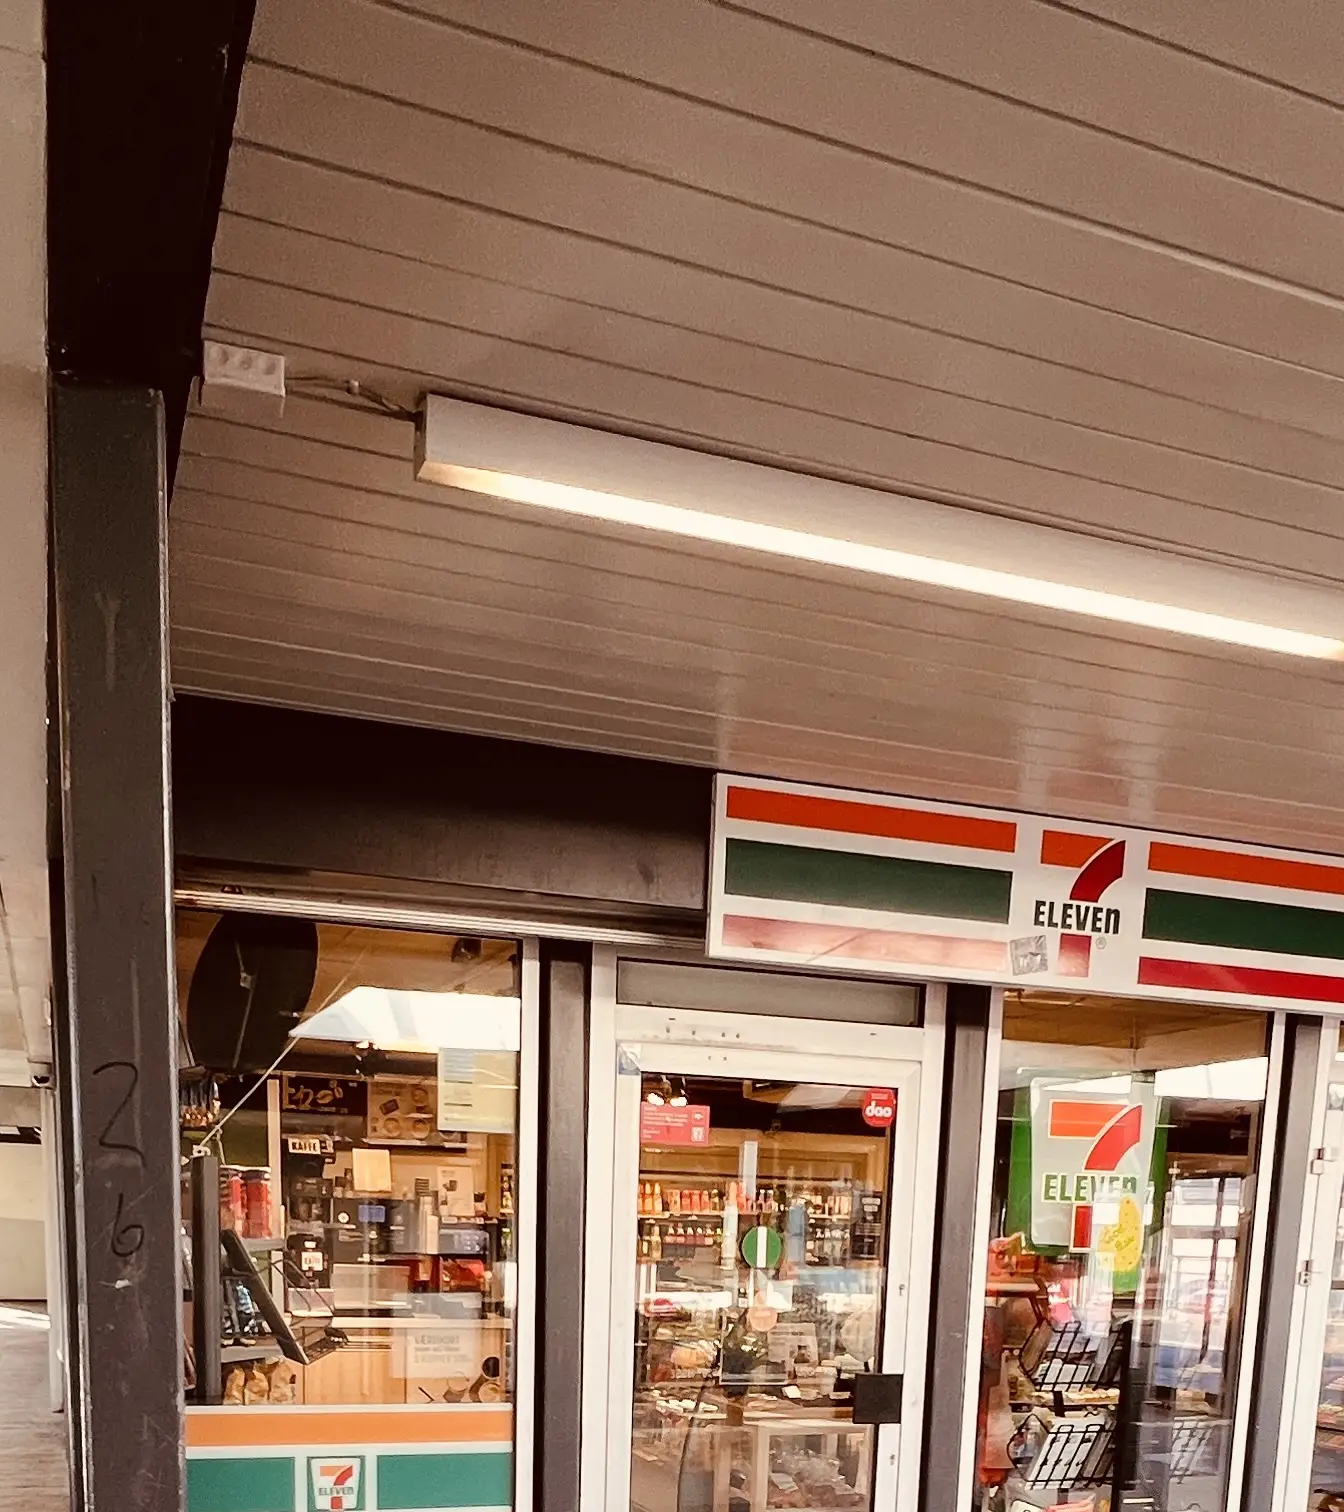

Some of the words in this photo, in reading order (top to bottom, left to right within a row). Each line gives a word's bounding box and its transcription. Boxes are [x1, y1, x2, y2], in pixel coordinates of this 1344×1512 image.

[1041, 830, 1125, 977] 7
[865, 1100, 893, 1118] dao
[1049, 1101, 1143, 1250] 7
[319, 1465, 354, 1510] 7
